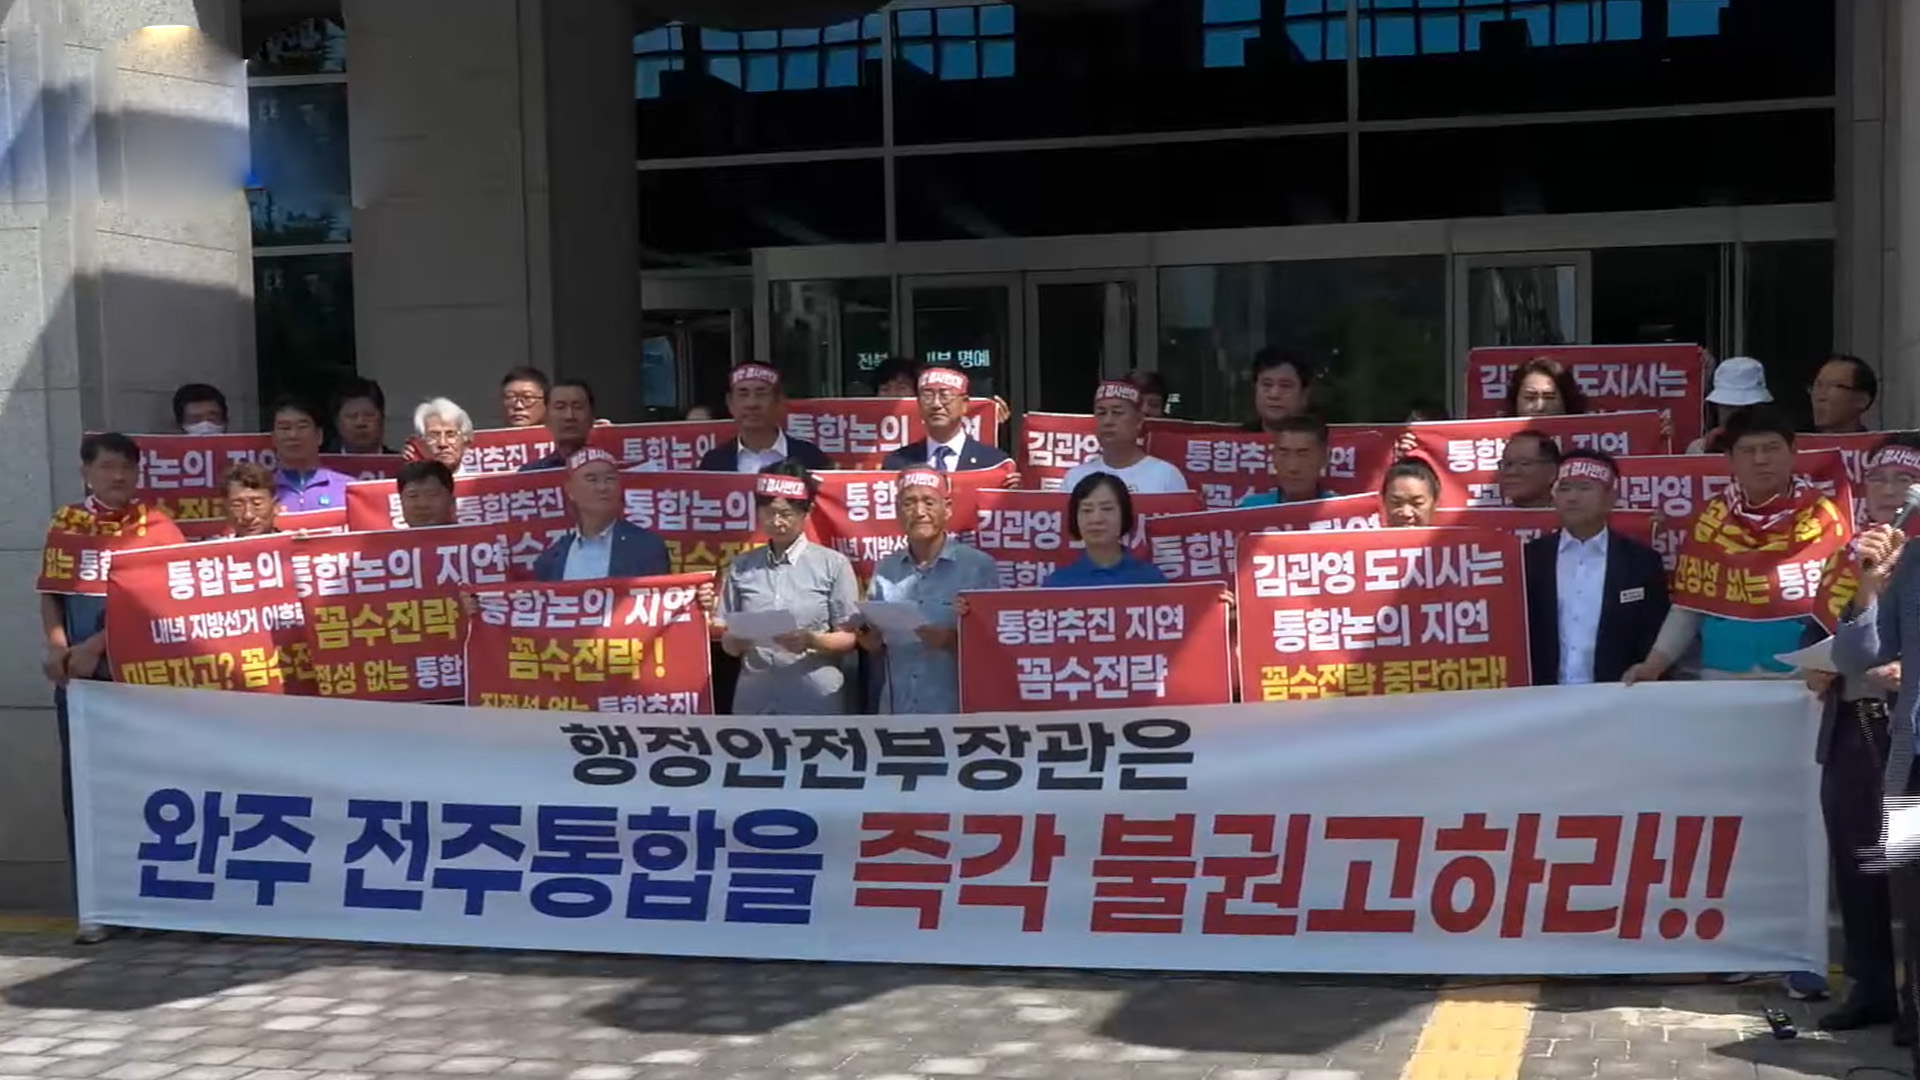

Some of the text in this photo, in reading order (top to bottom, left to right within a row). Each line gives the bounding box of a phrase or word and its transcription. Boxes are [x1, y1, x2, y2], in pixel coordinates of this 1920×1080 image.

[958, 349, 990, 368] 명예
[1572, 362, 1687, 399] 도지사는
[455, 487, 565, 526] 통합추진
[624, 488, 757, 533] 통합논의
[977, 509, 1062, 551] 김관영
[167, 550, 284, 601] 통합논의
[1253, 543, 1504, 597] 김관영 도지사는
[151, 616, 188, 644] 내년
[189, 607, 258, 640] 지방선거
[314, 597, 459, 649] 꼼수전략
[476, 585, 698, 628] 통합논의 지연
[996, 604, 1184, 645] 통합추진 지연
[1273, 599, 1489, 653] 통합논의 지연
[364, 659, 409, 693] 없는
[508, 636, 643, 682] 꼼수전략
[1017, 653, 1169, 702] 꼼수전략
[1261, 655, 1507, 702] 꼼수전략 중단하라!
[561, 720, 1194, 791] 행정안전부장관은
[138, 788, 1742, 940] 완주 전주통합을 즉각 불권고하라!!
